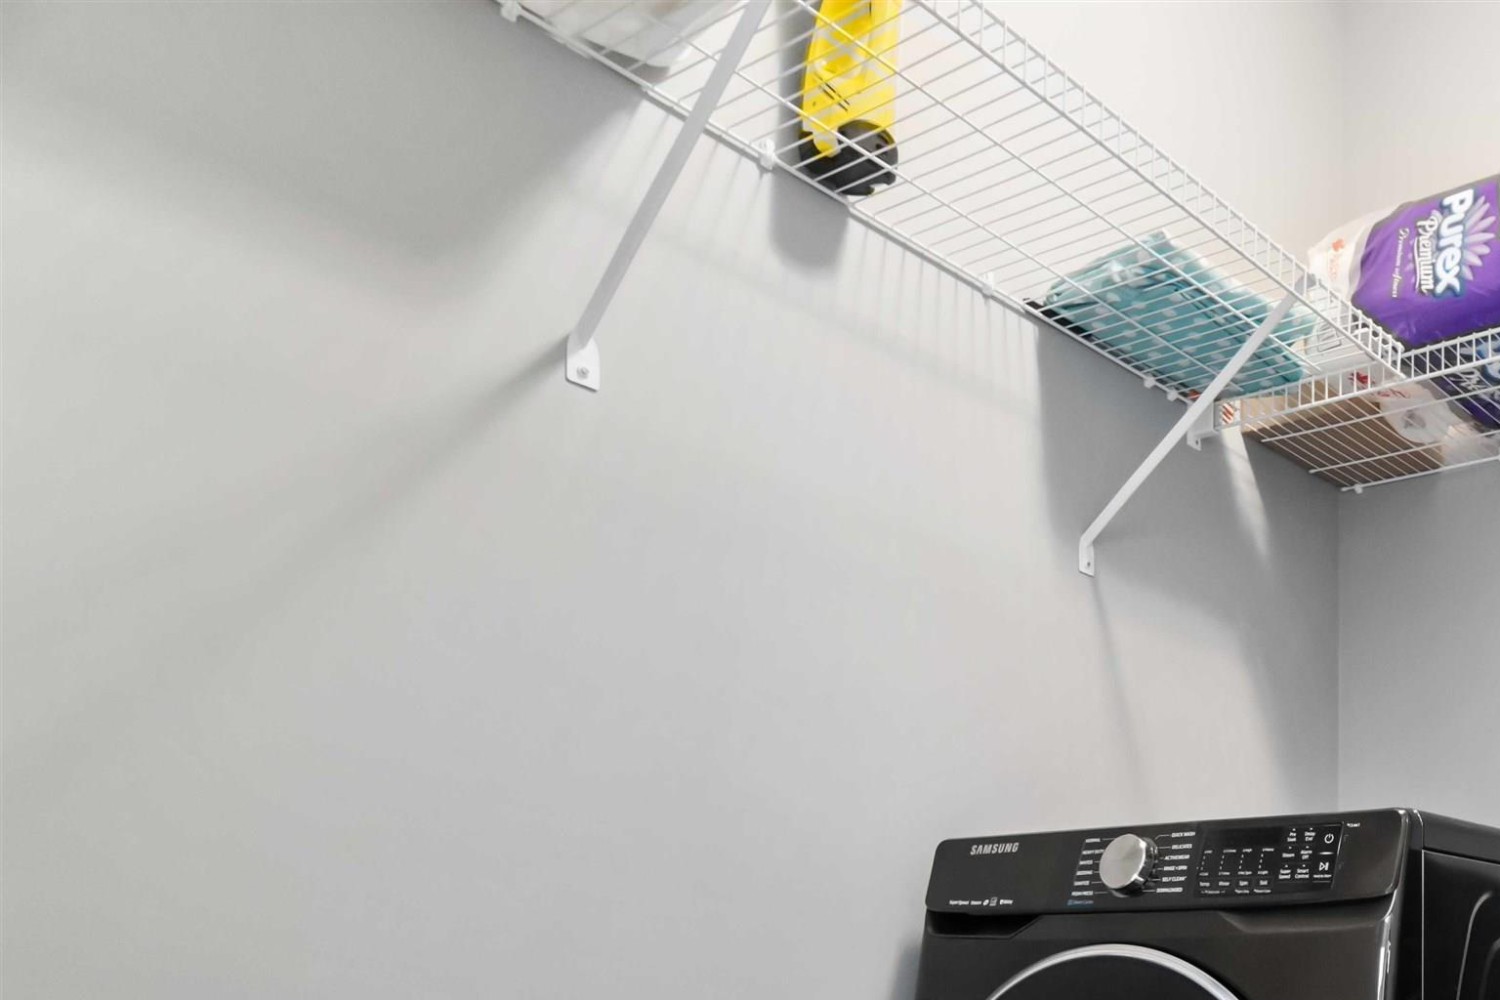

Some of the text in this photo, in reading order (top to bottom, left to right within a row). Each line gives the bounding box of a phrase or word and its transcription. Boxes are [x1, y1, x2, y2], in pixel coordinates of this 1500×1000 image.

[1415, 214, 1438, 295] Premium
[1435, 188, 1475, 295] Purex
[970, 842, 1020, 856] SAMSUNG
